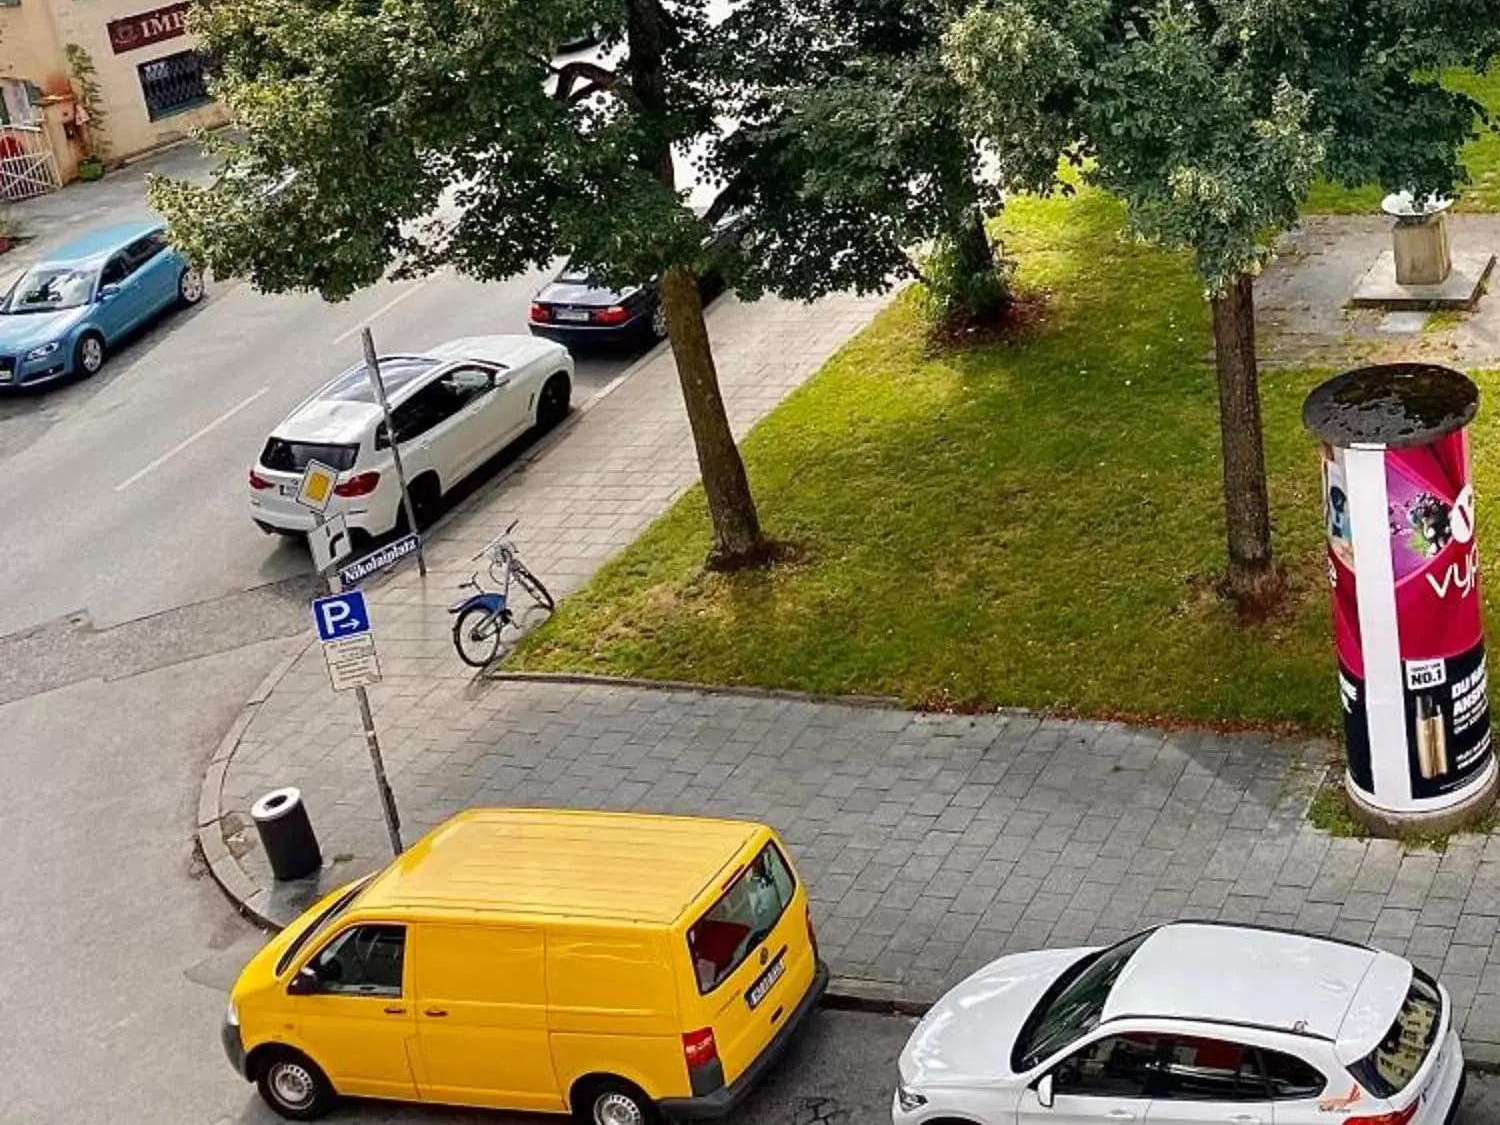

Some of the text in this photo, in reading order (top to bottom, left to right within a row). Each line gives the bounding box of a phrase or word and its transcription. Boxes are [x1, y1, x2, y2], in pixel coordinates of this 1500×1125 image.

[344, 539, 417, 582] Nikolaiplatz
[322, 600, 351, 635] P
[1411, 668, 1442, 685] NO.1
